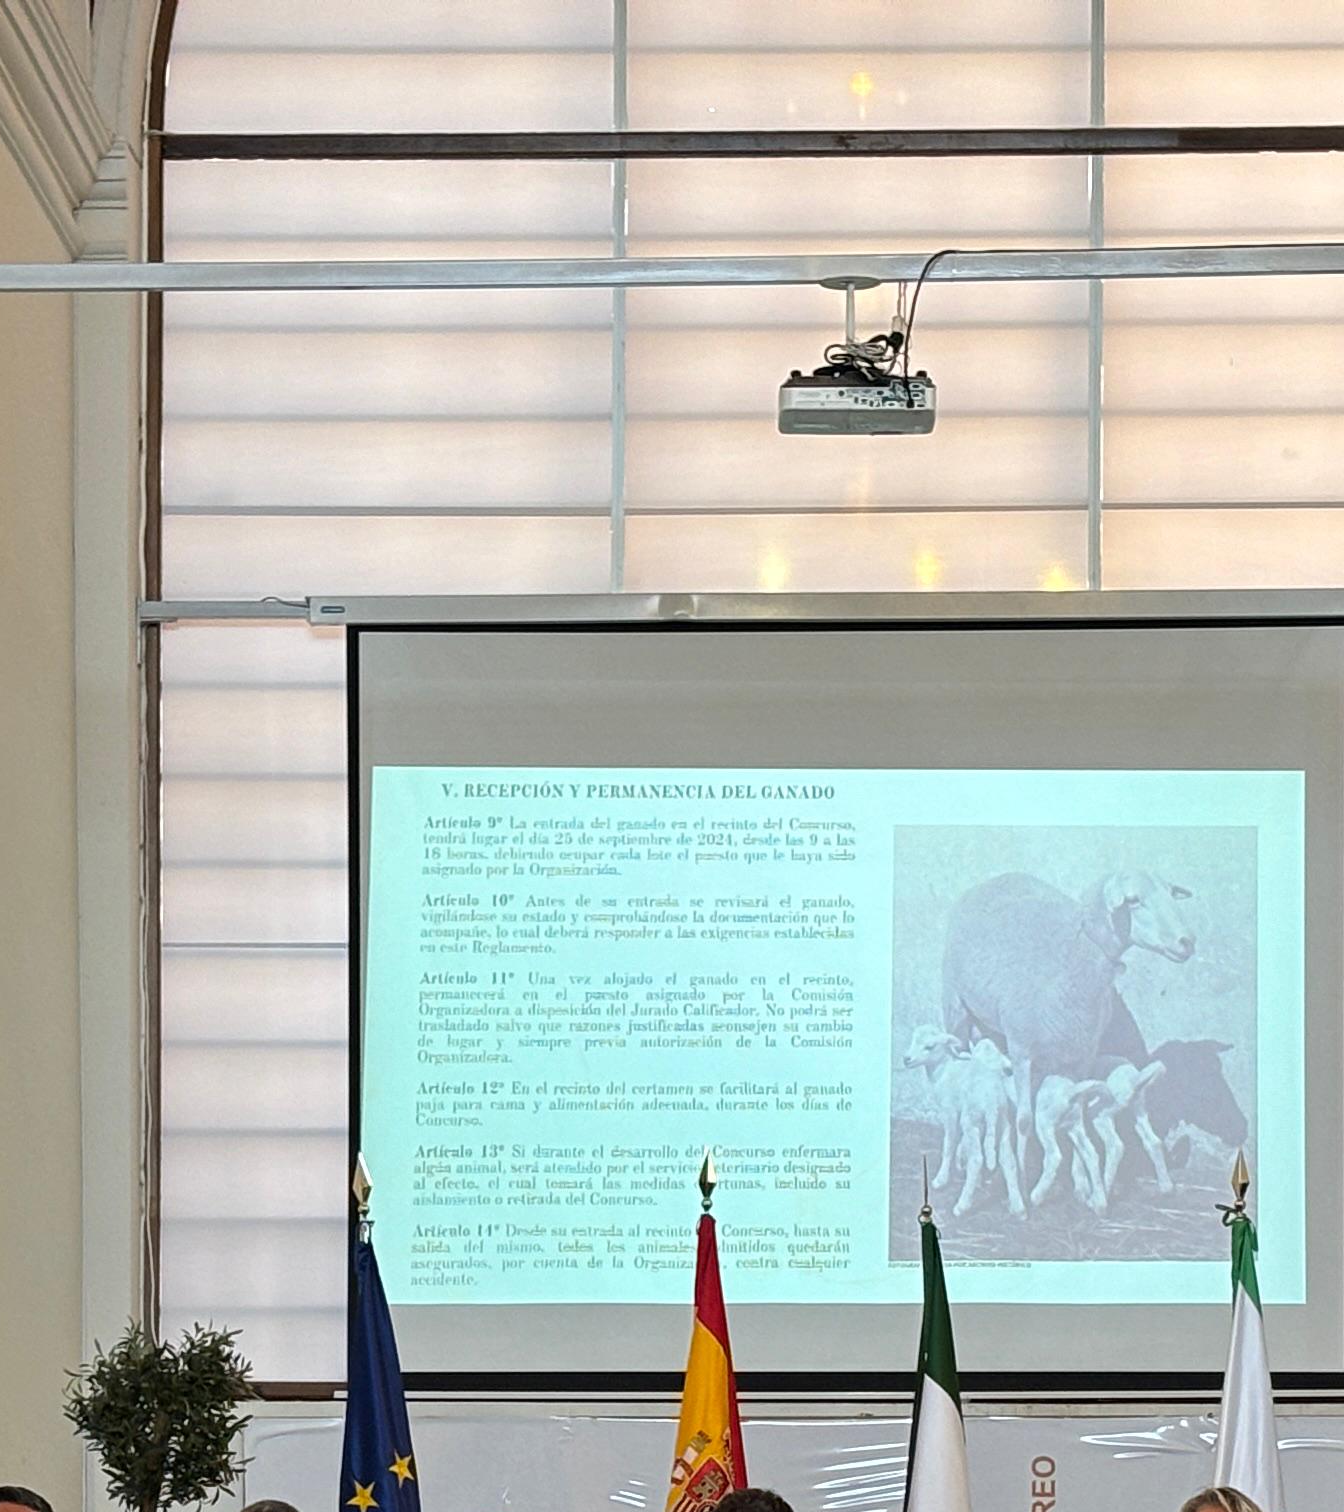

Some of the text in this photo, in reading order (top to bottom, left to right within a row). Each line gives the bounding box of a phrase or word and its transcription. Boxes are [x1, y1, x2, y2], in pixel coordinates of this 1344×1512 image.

[442, 781, 835, 799] V. RECEPCIÓN Y PERMANENCIA DEL GANADO
[424, 816, 481, 829] Artículo
[510, 817, 526, 829] La
[534, 817, 584, 829] entrada
[591, 817, 610, 829] del
[617, 817, 665, 832] ganado
[693, 817, 704, 830] el
[711, 817, 757, 830] recinto
[763, 818, 782, 830] del
[423, 832, 855, 848] tendrá lugar el día 25 de septiembre de 2024, desde las 9 a las
[422, 894, 479, 907] Artículo
[526, 895, 565, 907] Antes
[576, 895, 591, 907] de
[602, 898, 616, 907] su
[627, 894, 679, 907] entrada
[690, 898, 703, 907] se
[715, 895, 769, 907] revisará
[780, 895, 791, 908] el
[802, 895, 854, 910] ganado,
[420, 972, 477, 984] Artículo
[528, 972, 555, 985] Una
[569, 975, 591, 985] vez
[604, 972, 653, 988] alojado
[665, 972, 677, 985] el
[690, 972, 738, 988] ganado
[751, 975, 766, 985] en
[779, 972, 790, 985] el
[803, 973, 853, 987] recinto,
[417, 1082, 474, 1094] Artículo
[512, 1082, 530, 1094] En
[536, 1082, 547, 1094] el
[554, 1082, 600, 1095] recinto
[606, 1082, 625, 1095] del
[632, 1084, 693, 1095] certamen
[699, 1086, 713, 1095] se
[720, 1082, 778, 1095] facilitará
[785, 1082, 797, 1095] al
[804, 1082, 852, 1098] ganado
[415, 1145, 472, 1158] Artículo
[413, 1225, 470, 1237] Artículo
